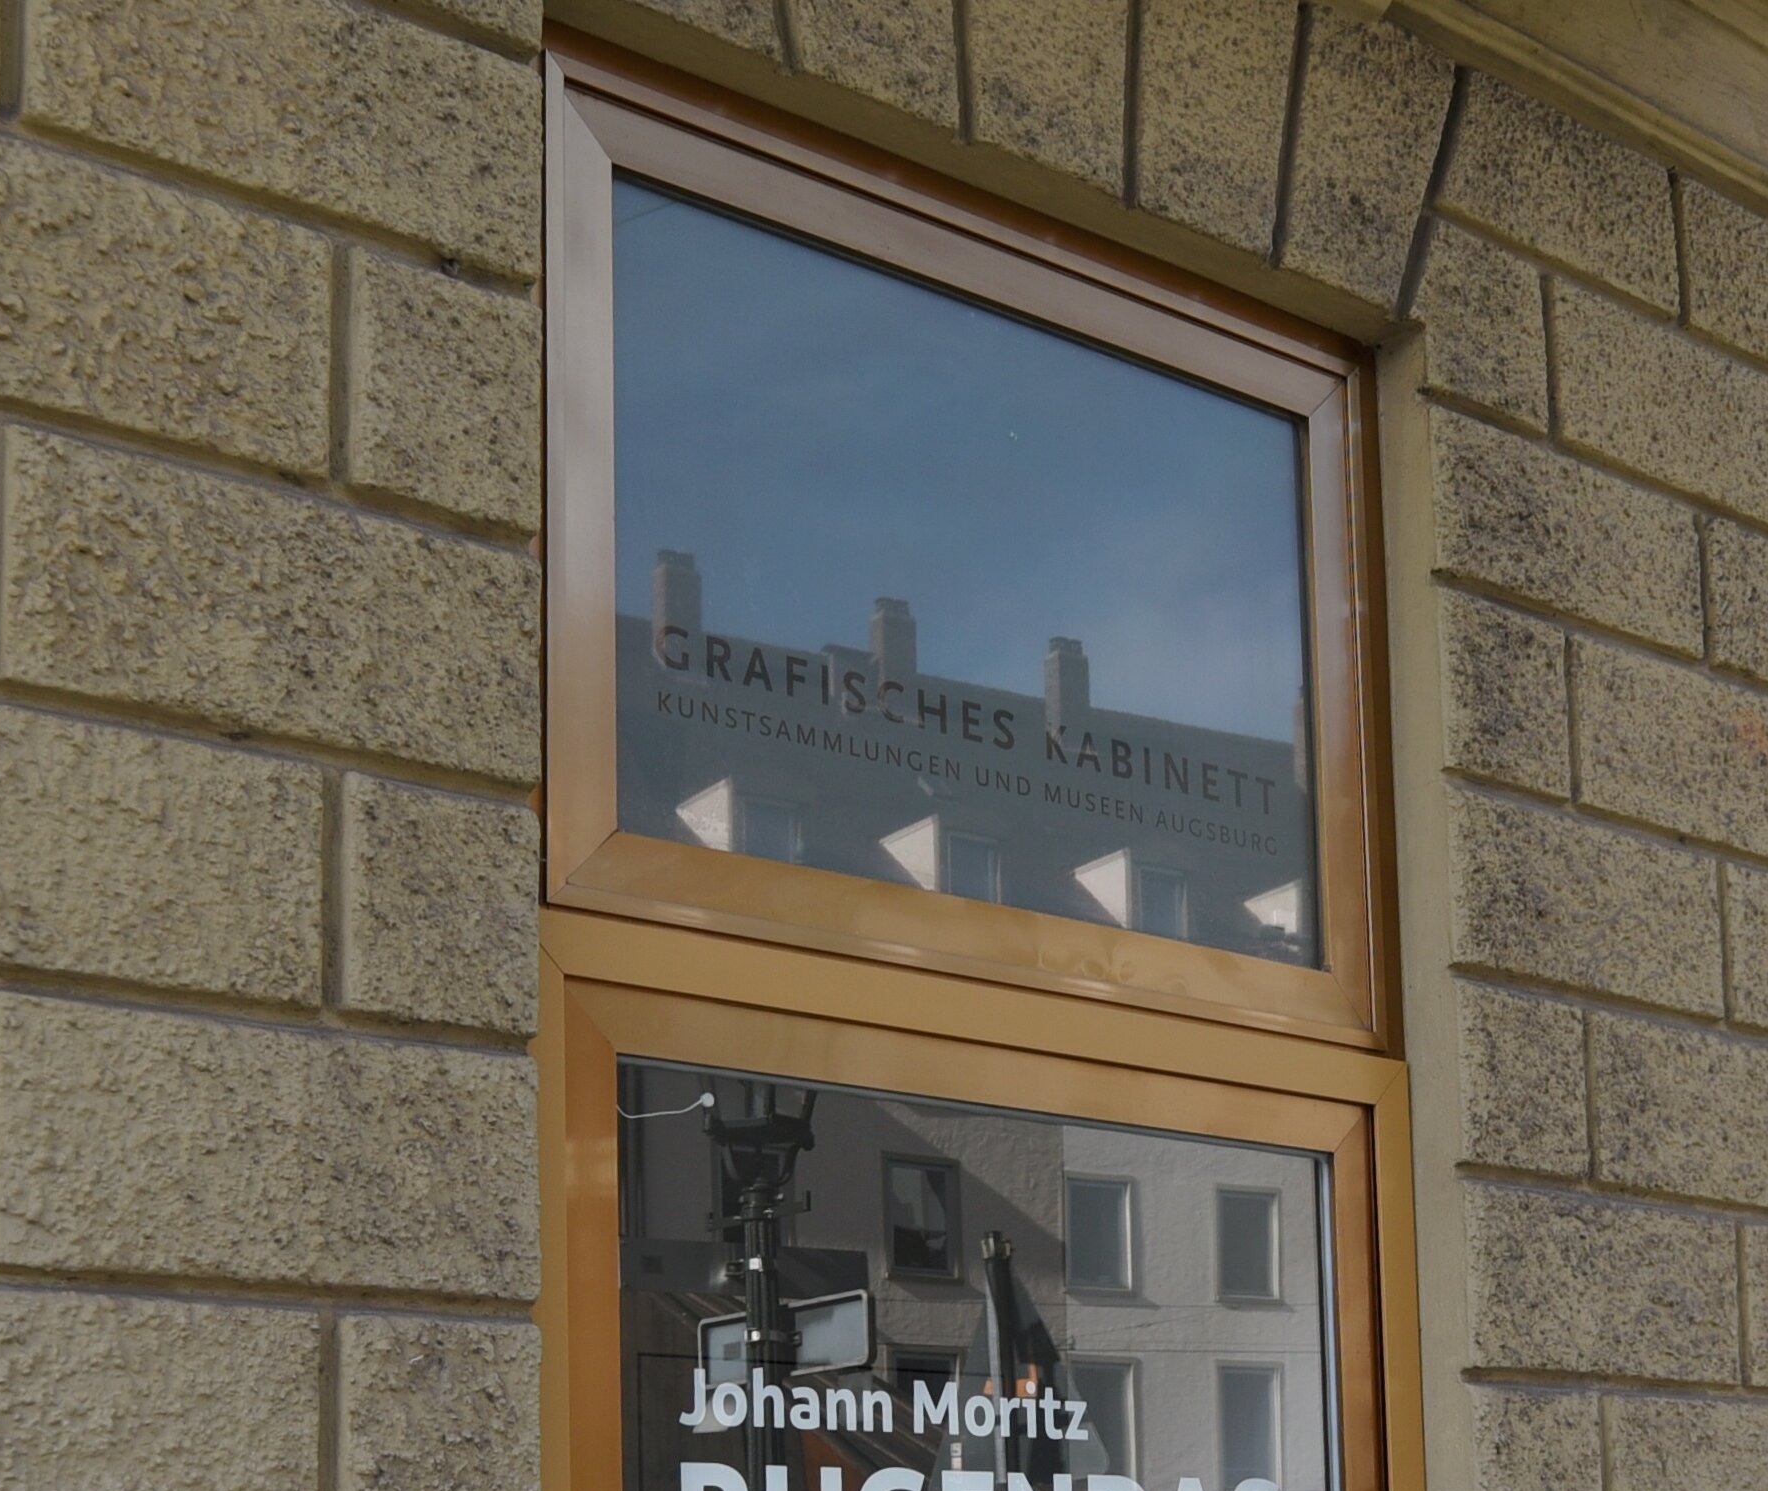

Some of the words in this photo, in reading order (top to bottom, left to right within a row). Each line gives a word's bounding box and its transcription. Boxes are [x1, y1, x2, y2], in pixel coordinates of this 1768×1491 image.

[657, 625, 1015, 750] GRAFISCHES
[1046, 725, 1276, 815] KABINETT
[657, 691, 961, 782] KUNSTSAMMLUNGEN
[974, 764, 1031, 797] UND
[1044, 781, 1144, 824] MUSEEN
[1154, 808, 1278, 856] AUGSBURG
[678, 1367, 894, 1434] Johann
[912, 1379, 1089, 1441] Moritz
